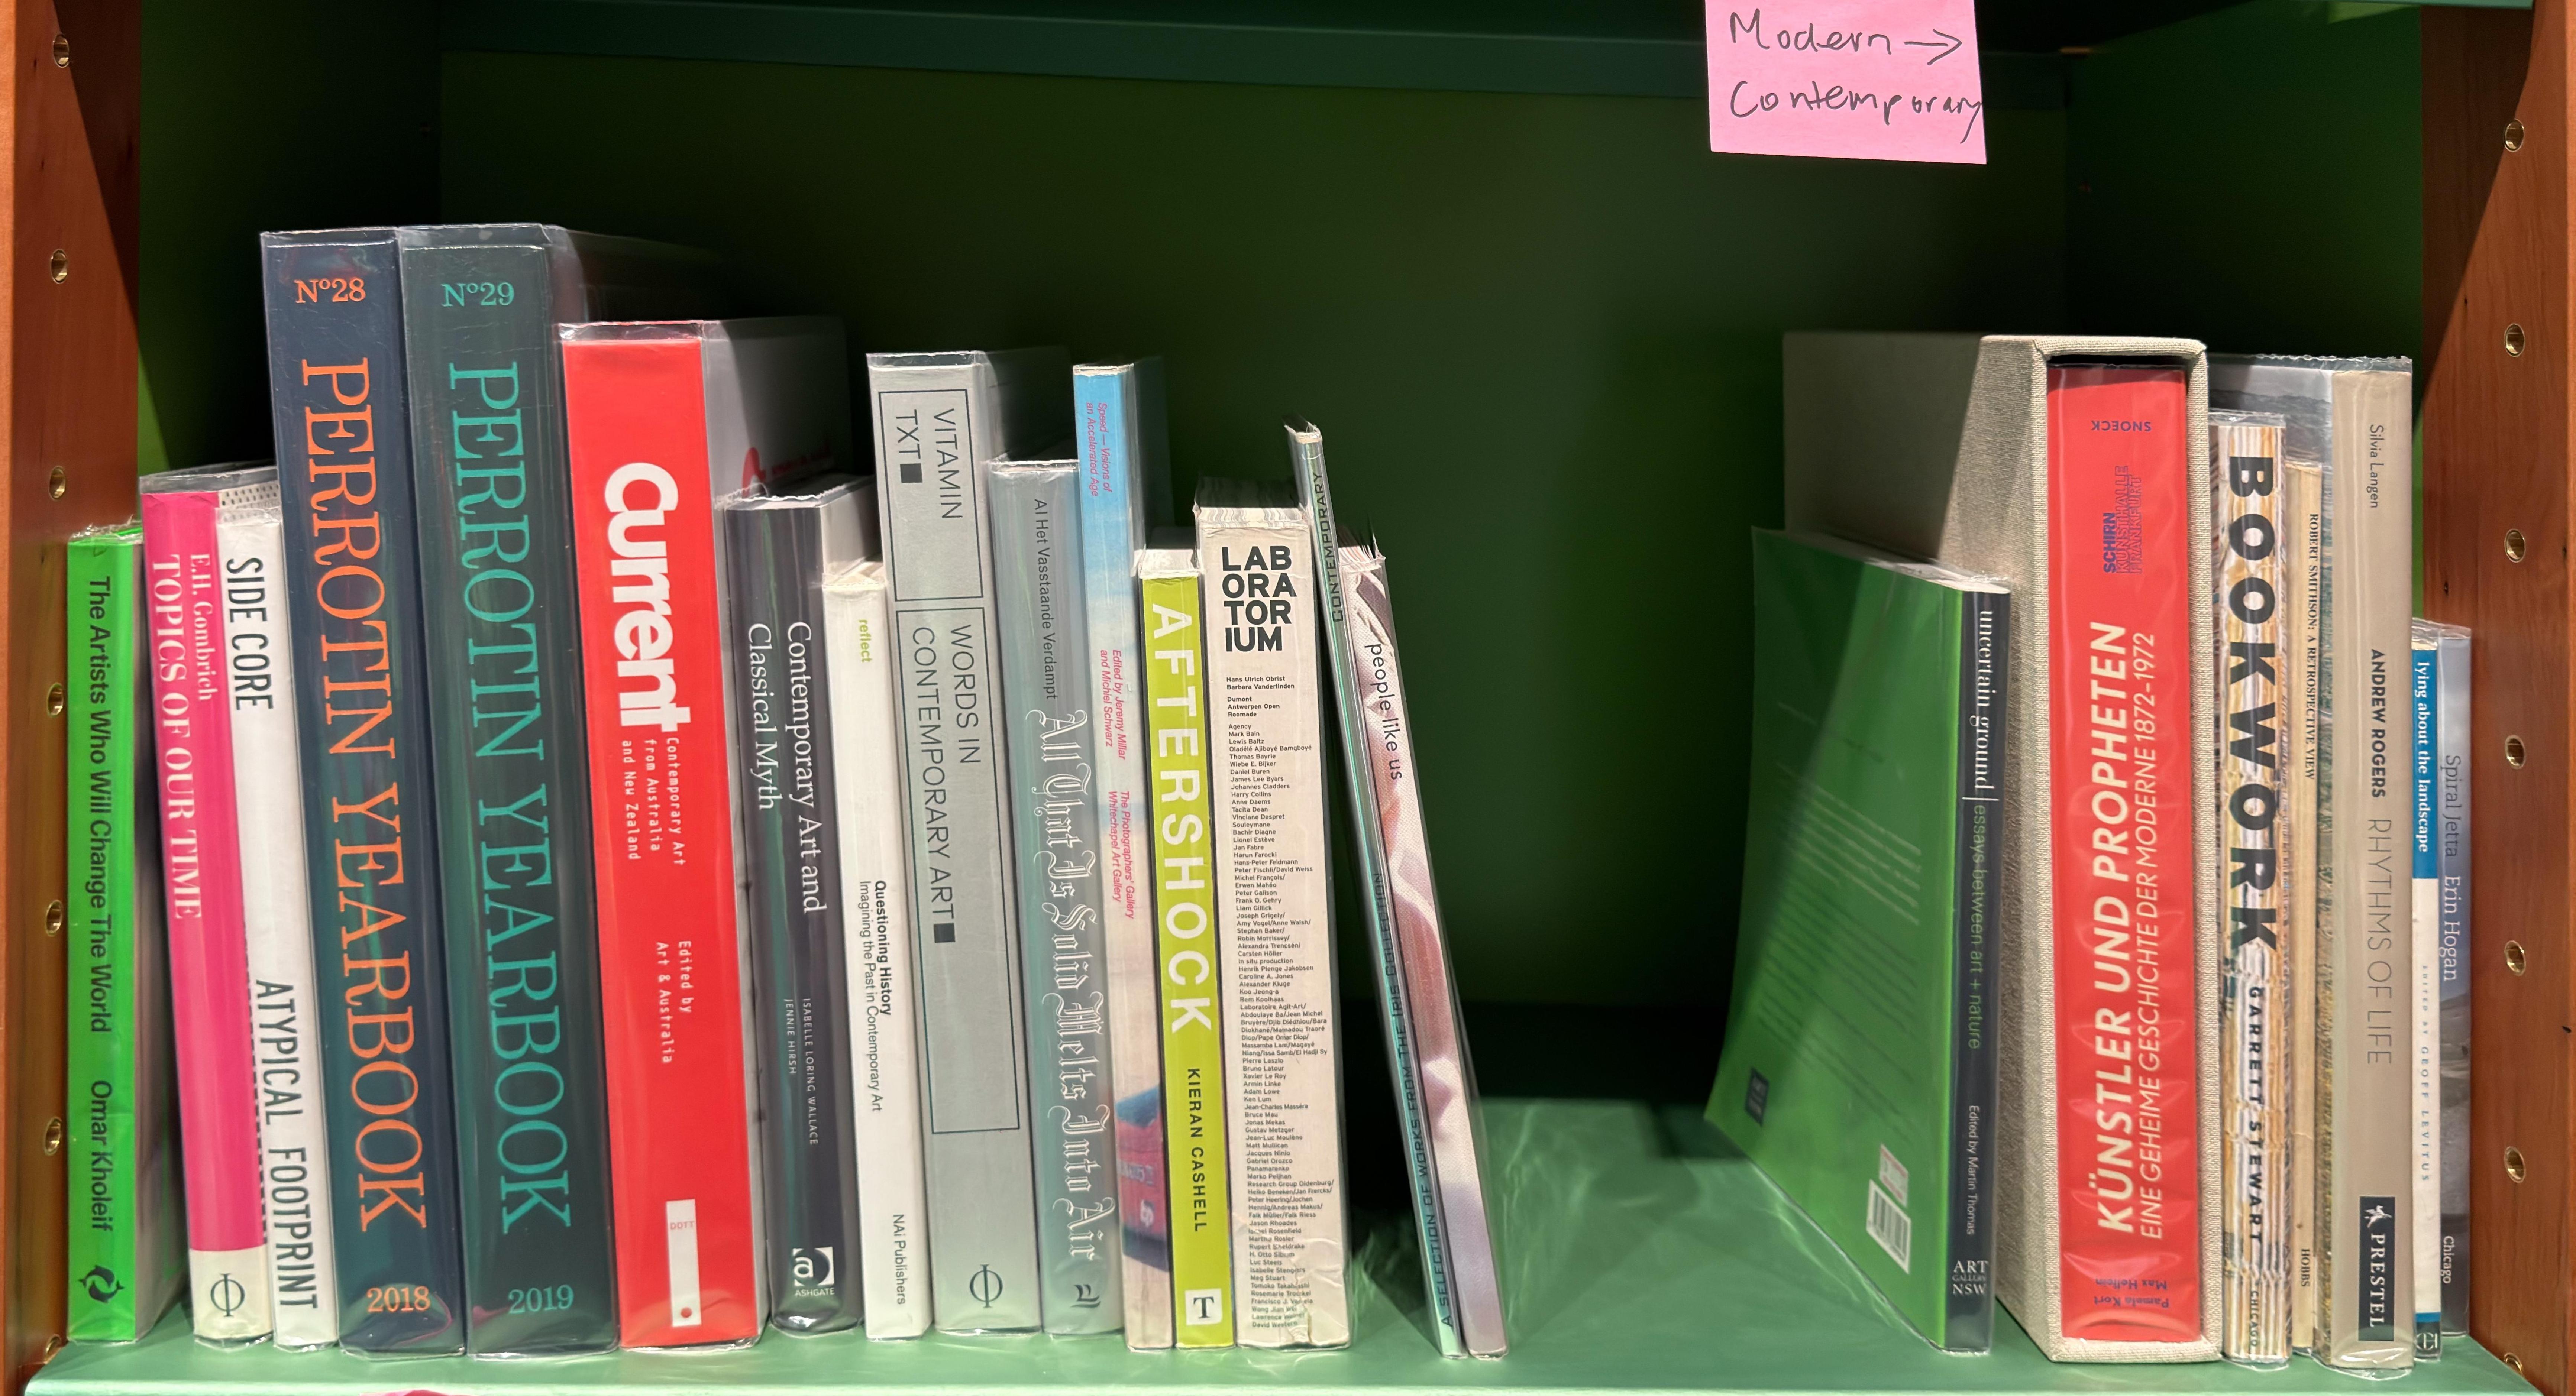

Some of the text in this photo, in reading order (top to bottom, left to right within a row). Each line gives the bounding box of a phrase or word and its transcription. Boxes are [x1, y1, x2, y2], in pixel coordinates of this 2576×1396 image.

[1729, 8, 1891, 54] Modern
[1730, 80, 1982, 144] Contemporary
[896, 409, 921, 459] TXT
[934, 408, 963, 519] VITAMIN
[2091, 421, 2152, 431] SNOECK
[2366, 424, 2384, 508] Silvia Langen
[1036, 519, 1049, 544] Het
[1037, 545, 1052, 628] Vasstaande
[1222, 546, 1292, 571] LAB
[1222, 573, 1297, 598] ORA
[1311, 473, 1344, 622] CONTEMPORARY
[2103, 512, 2116, 573] SCHIRN
[2310, 514, 2318, 561] ROBERT
[190, 554, 218, 701] E.H. Gombrich
[227, 558, 273, 710] SIDE CORE
[605, 463, 691, 732] Current
[858, 619, 873, 663] reflect
[1224, 600, 1292, 625] TOR
[1225, 627, 1282, 652] IUM
[2308, 565, 2318, 630] SMITHSON:
[748, 623, 783, 810] Classical Myth
[950, 625, 981, 763] WORDS IN
[1043, 632, 1058, 700] Verdampt
[1100, 650, 1114, 747] and Michiel Schwarz
[1113, 650, 1127, 760] Edited by Jeremy Millar
[1365, 643, 1402, 780] people like us
[1969, 610, 1997, 790] uncertain ground
[2229, 457, 2276, 951] BOOKWORK
[2305, 647, 2316, 744] RETROSPECTIVE
[153, 554, 201, 919] TOPICS OF OUR TIME
[785, 622, 827, 914] Contemporary Art and
[912, 627, 954, 919] CONTEMPORARY ART
[2305, 748, 2315, 780] VIEW
[2414, 661, 2431, 852] lying about the landscape
[302, 358, 426, 1231] PERROTIN YEARBOOK
[450, 362, 571, 1234] PERROTIN YEARBOOK
[622, 740, 641, 859] and New Zealand
[644, 739, 660, 852] from Australia
[666, 737, 686, 865] Contemporary Art
[1153, 604, 1211, 1032] AFTERSHOCK
[2134, 748, 2158, 868] MODERNE
[84, 576, 113, 1232] The Artists Who Will Change The World Omar Kholeif
[2136, 874, 2157, 918] DER
[2367, 649, 2392, 1064] ANDREW ROGERS RHYTHMS OF LIFE
[2439, 755, 2462, 981] Spiral Jetta Erin Hogan
[875, 880, 892, 1016] Questioning History
[1968, 805, 1988, 1049] essays between art + nature
[2089, 621, 2133, 1233] KÜNSTLER UND PROPHETEN
[783, 998, 797, 1075] JENNIE HIRSH
[859, 881, 883, 1111] Imagining the Past in Contemporary Art
[1025, 709, 1115, 1261] All That Is Solid Melts Into Air
[2137, 922, 2160, 1072] GESCHICHTE
[802, 997, 818, 1145] ISABELLE LORING WALLACE
[2249, 987, 2262, 1241] GARRETT STEWART
[2421, 1047, 2430, 1181] GEOFF LEVITUS
[255, 980, 318, 1309] ATYPICAL FOOTPRINT
[1187, 1068, 1207, 1231] KIERAN CASHELL
[2139, 1077, 2162, 1183] GEHEIME
[893, 1214, 907, 1305] NAi Publishers
[1953, 1260, 1988, 1273] ART
[2140, 1187, 2163, 1240] EINE
[2301, 1249, 2311, 1287] HOBBS
[2441, 1236, 2453, 1284] Chicago
[366, 1287, 431, 1312] 2018
[509, 1285, 574, 1314] 2019
[1953, 1284, 1986, 1295] NSW
[2370, 1233, 2386, 1327] PRESTEL
